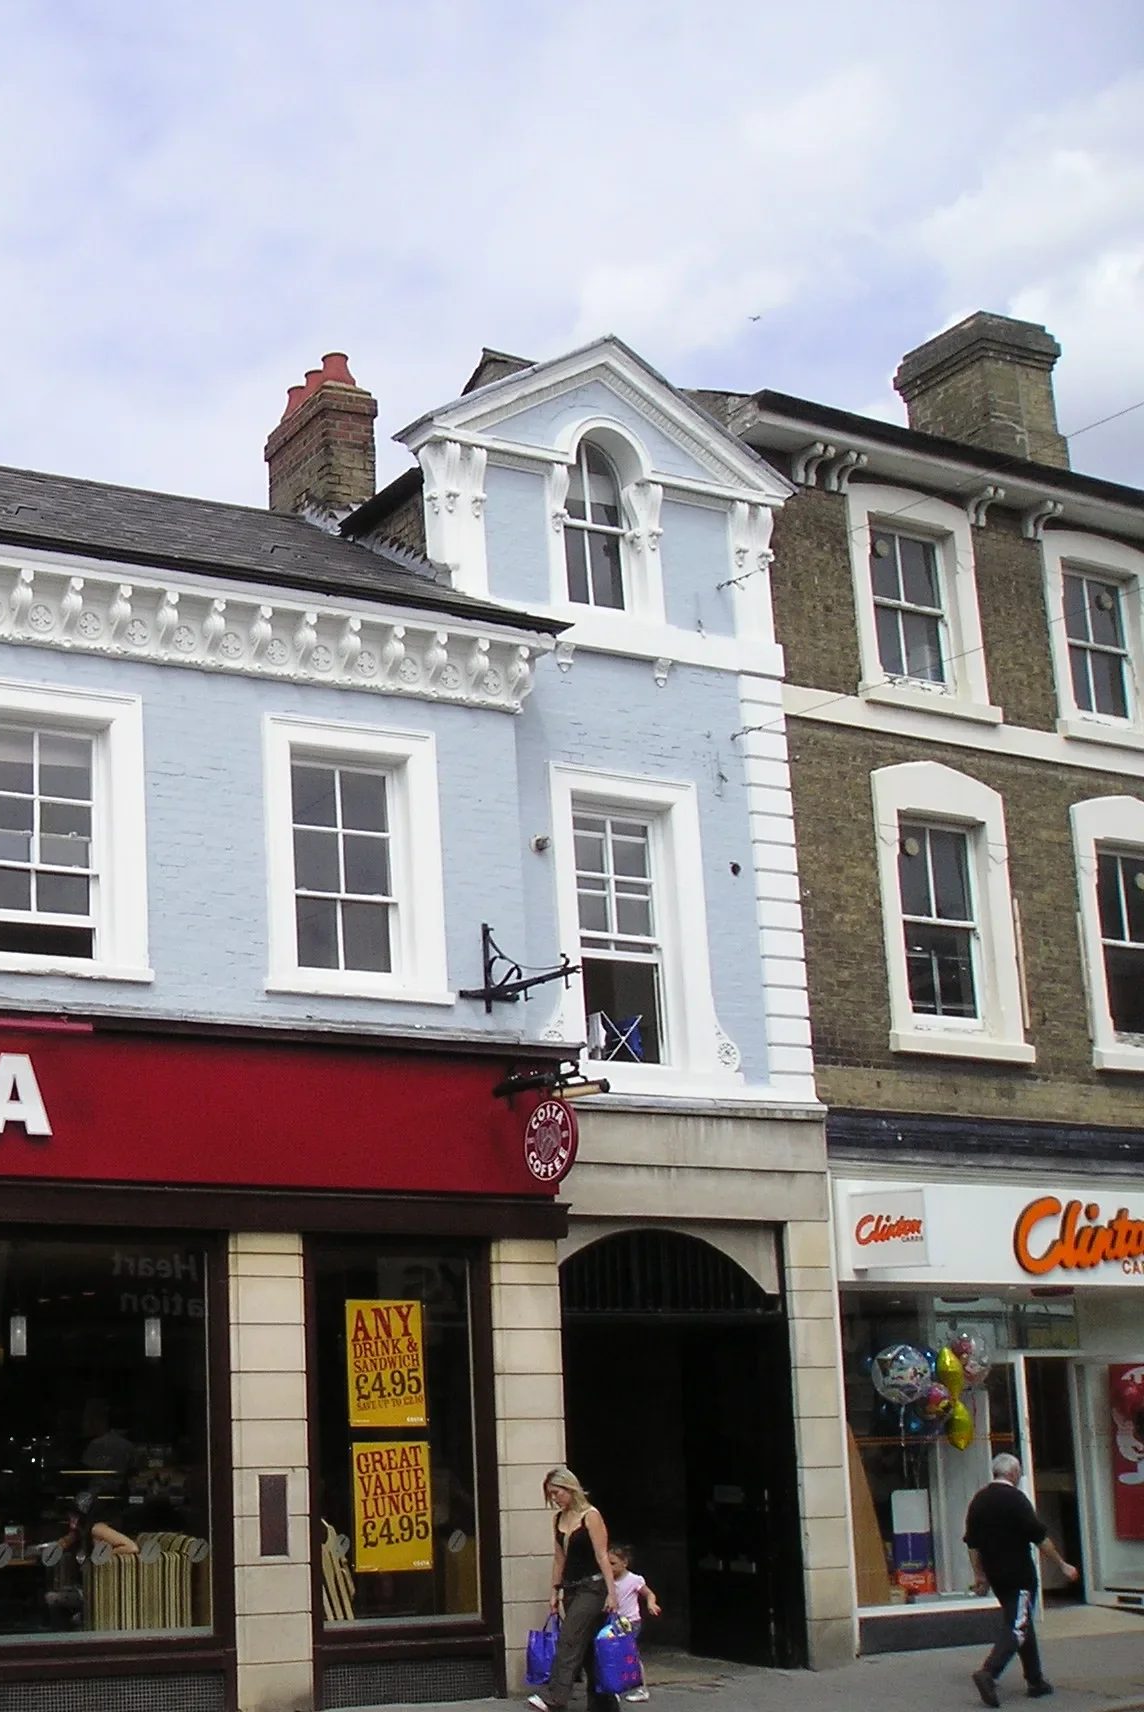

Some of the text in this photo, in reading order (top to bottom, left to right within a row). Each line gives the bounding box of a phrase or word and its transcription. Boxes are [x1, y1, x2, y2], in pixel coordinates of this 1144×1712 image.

[531, 1104, 564, 1130] COSTA
[528, 1146, 568, 1177] COFFEE
[855, 1213, 923, 1246] Clinton
[1013, 1195, 1144, 1276] Clinto
[1121, 1259, 1144, 1275] CA
[351, 1304, 415, 1342] ANY
[352, 1336, 419, 1359] DRINK &
[353, 1353, 420, 1374] SANDWICH
[355, 1367, 423, 1402] £4.95
[356, 1445, 423, 1475] GREAT
[358, 1467, 426, 1498] VALUE
[361, 1489, 428, 1520] LUNCH
[362, 1512, 430, 1549] £4.95
